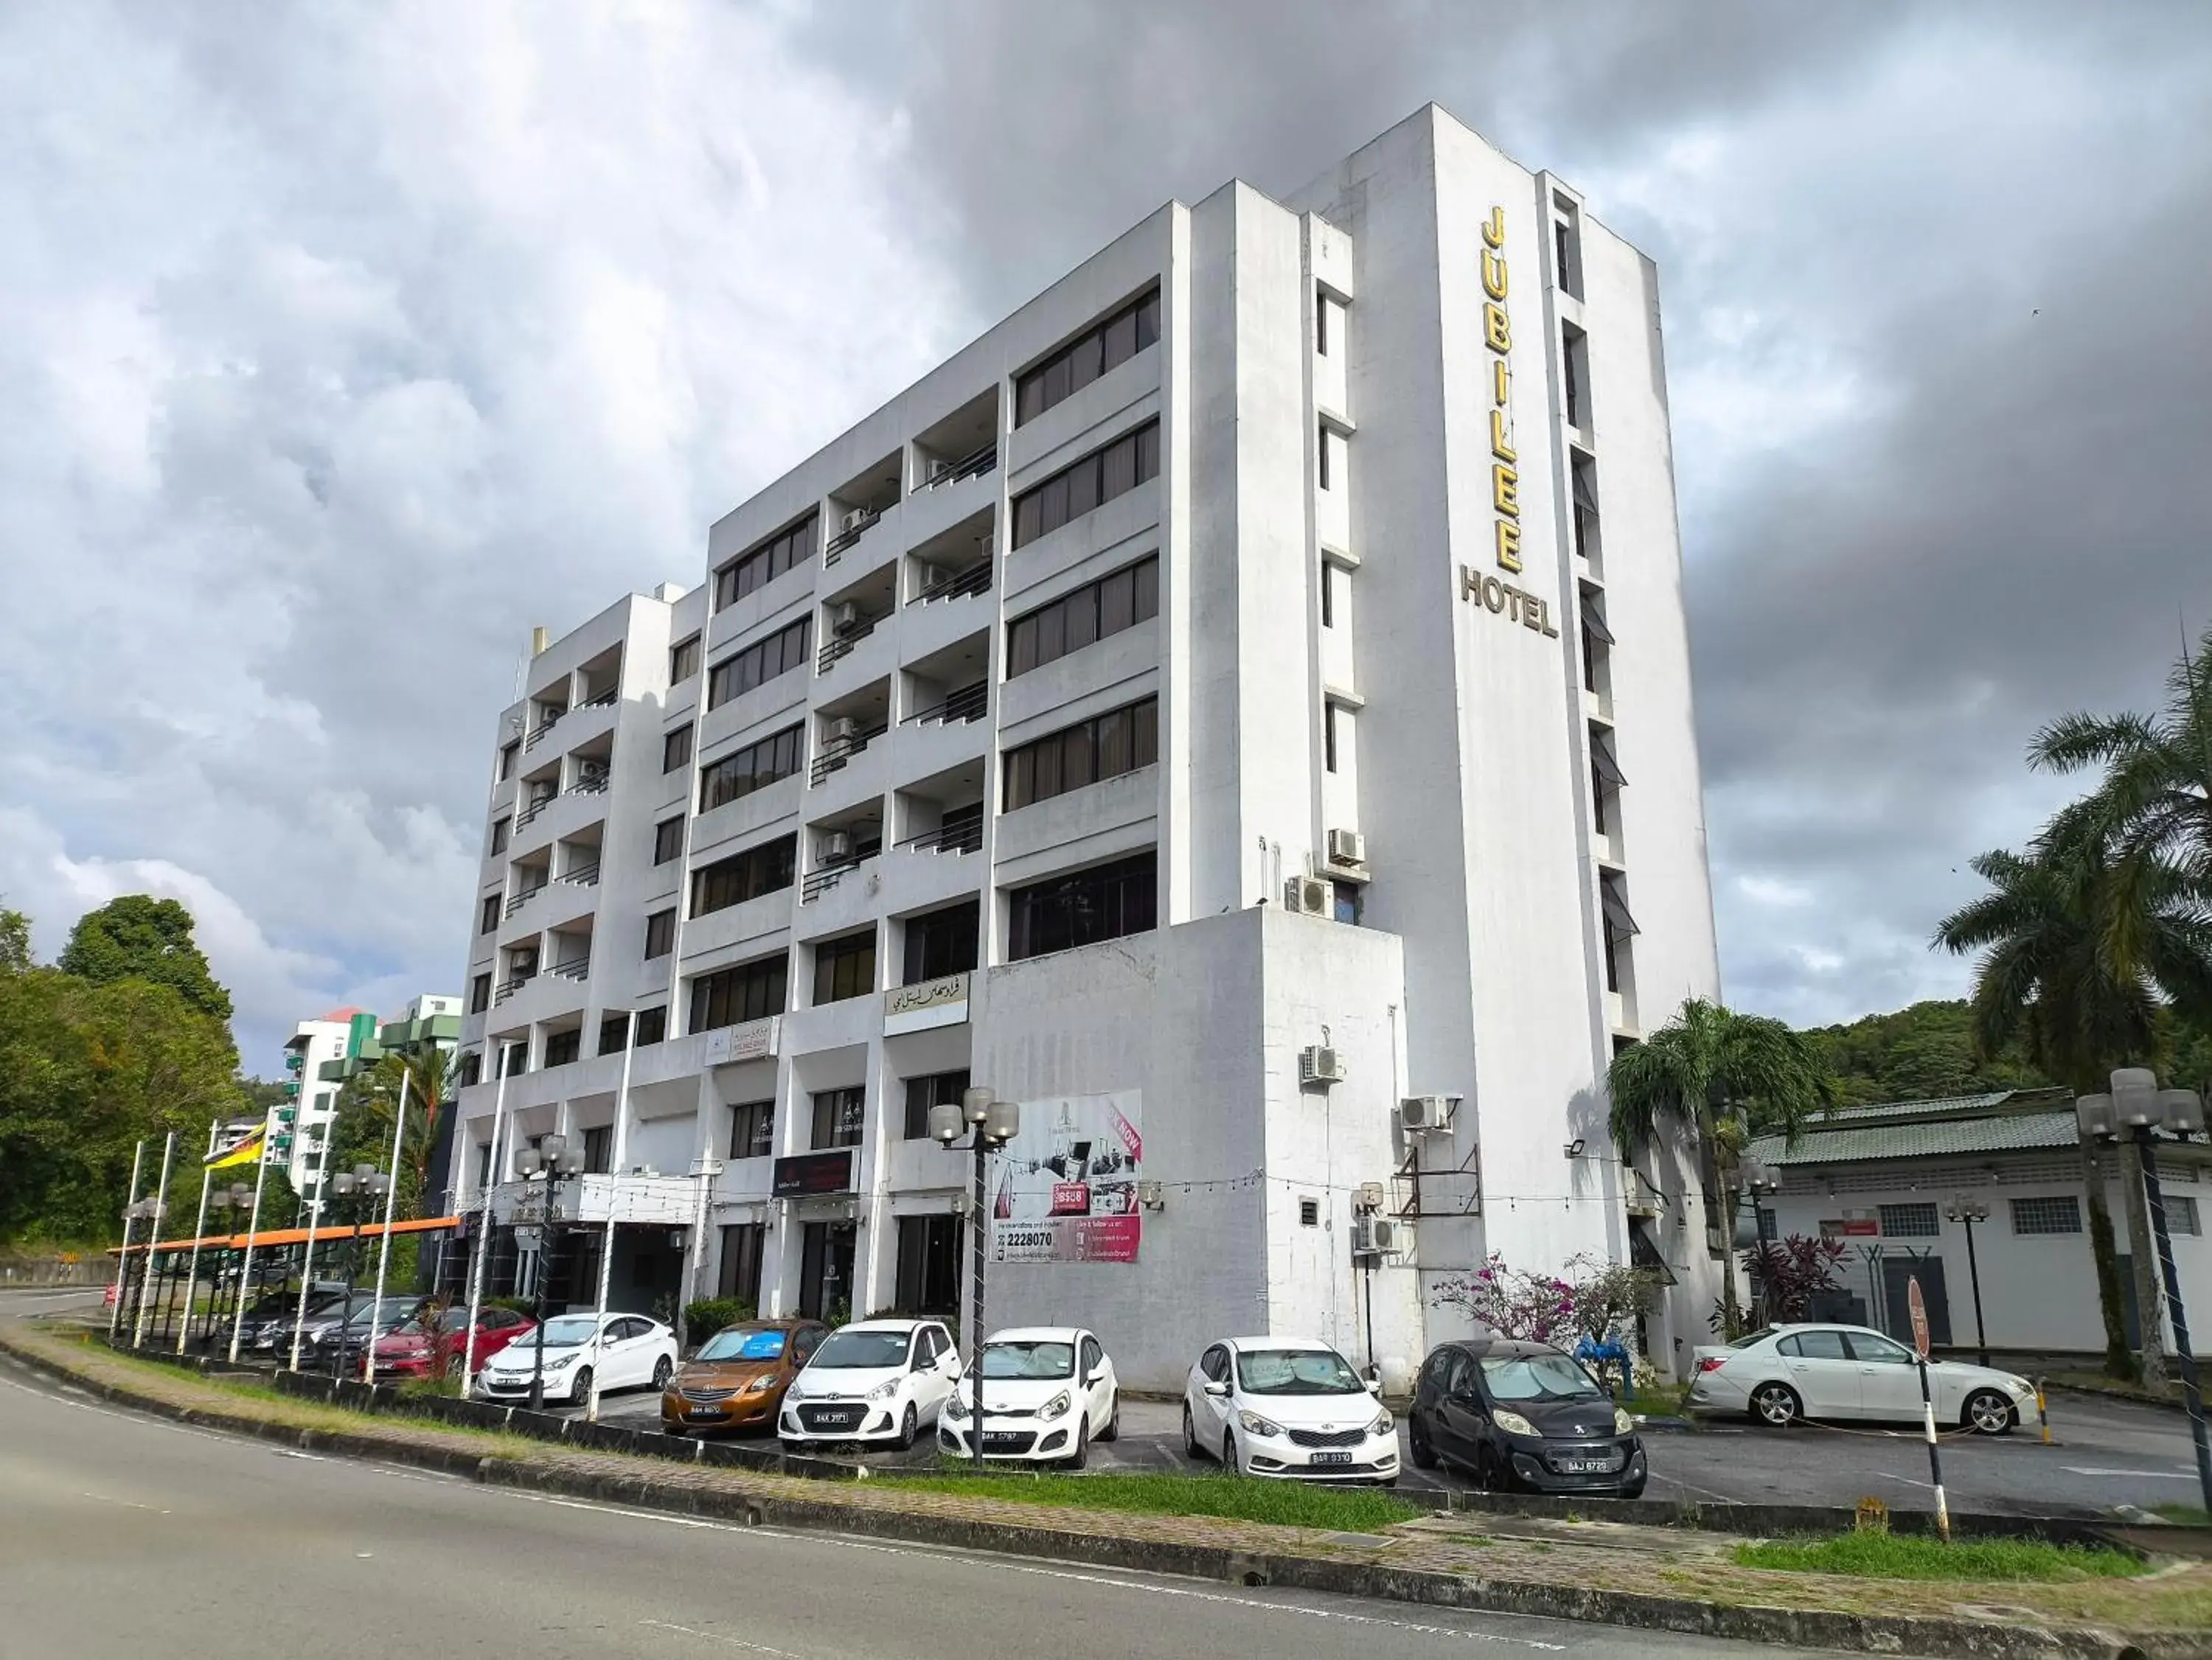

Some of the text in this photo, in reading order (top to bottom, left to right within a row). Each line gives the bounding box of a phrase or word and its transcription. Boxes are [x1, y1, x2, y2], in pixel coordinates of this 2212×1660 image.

[1481, 206, 1522, 573] JUBILEE
[1461, 564, 1558, 639] HOTEL
[1007, 1232, 1052, 1246] 2228070
